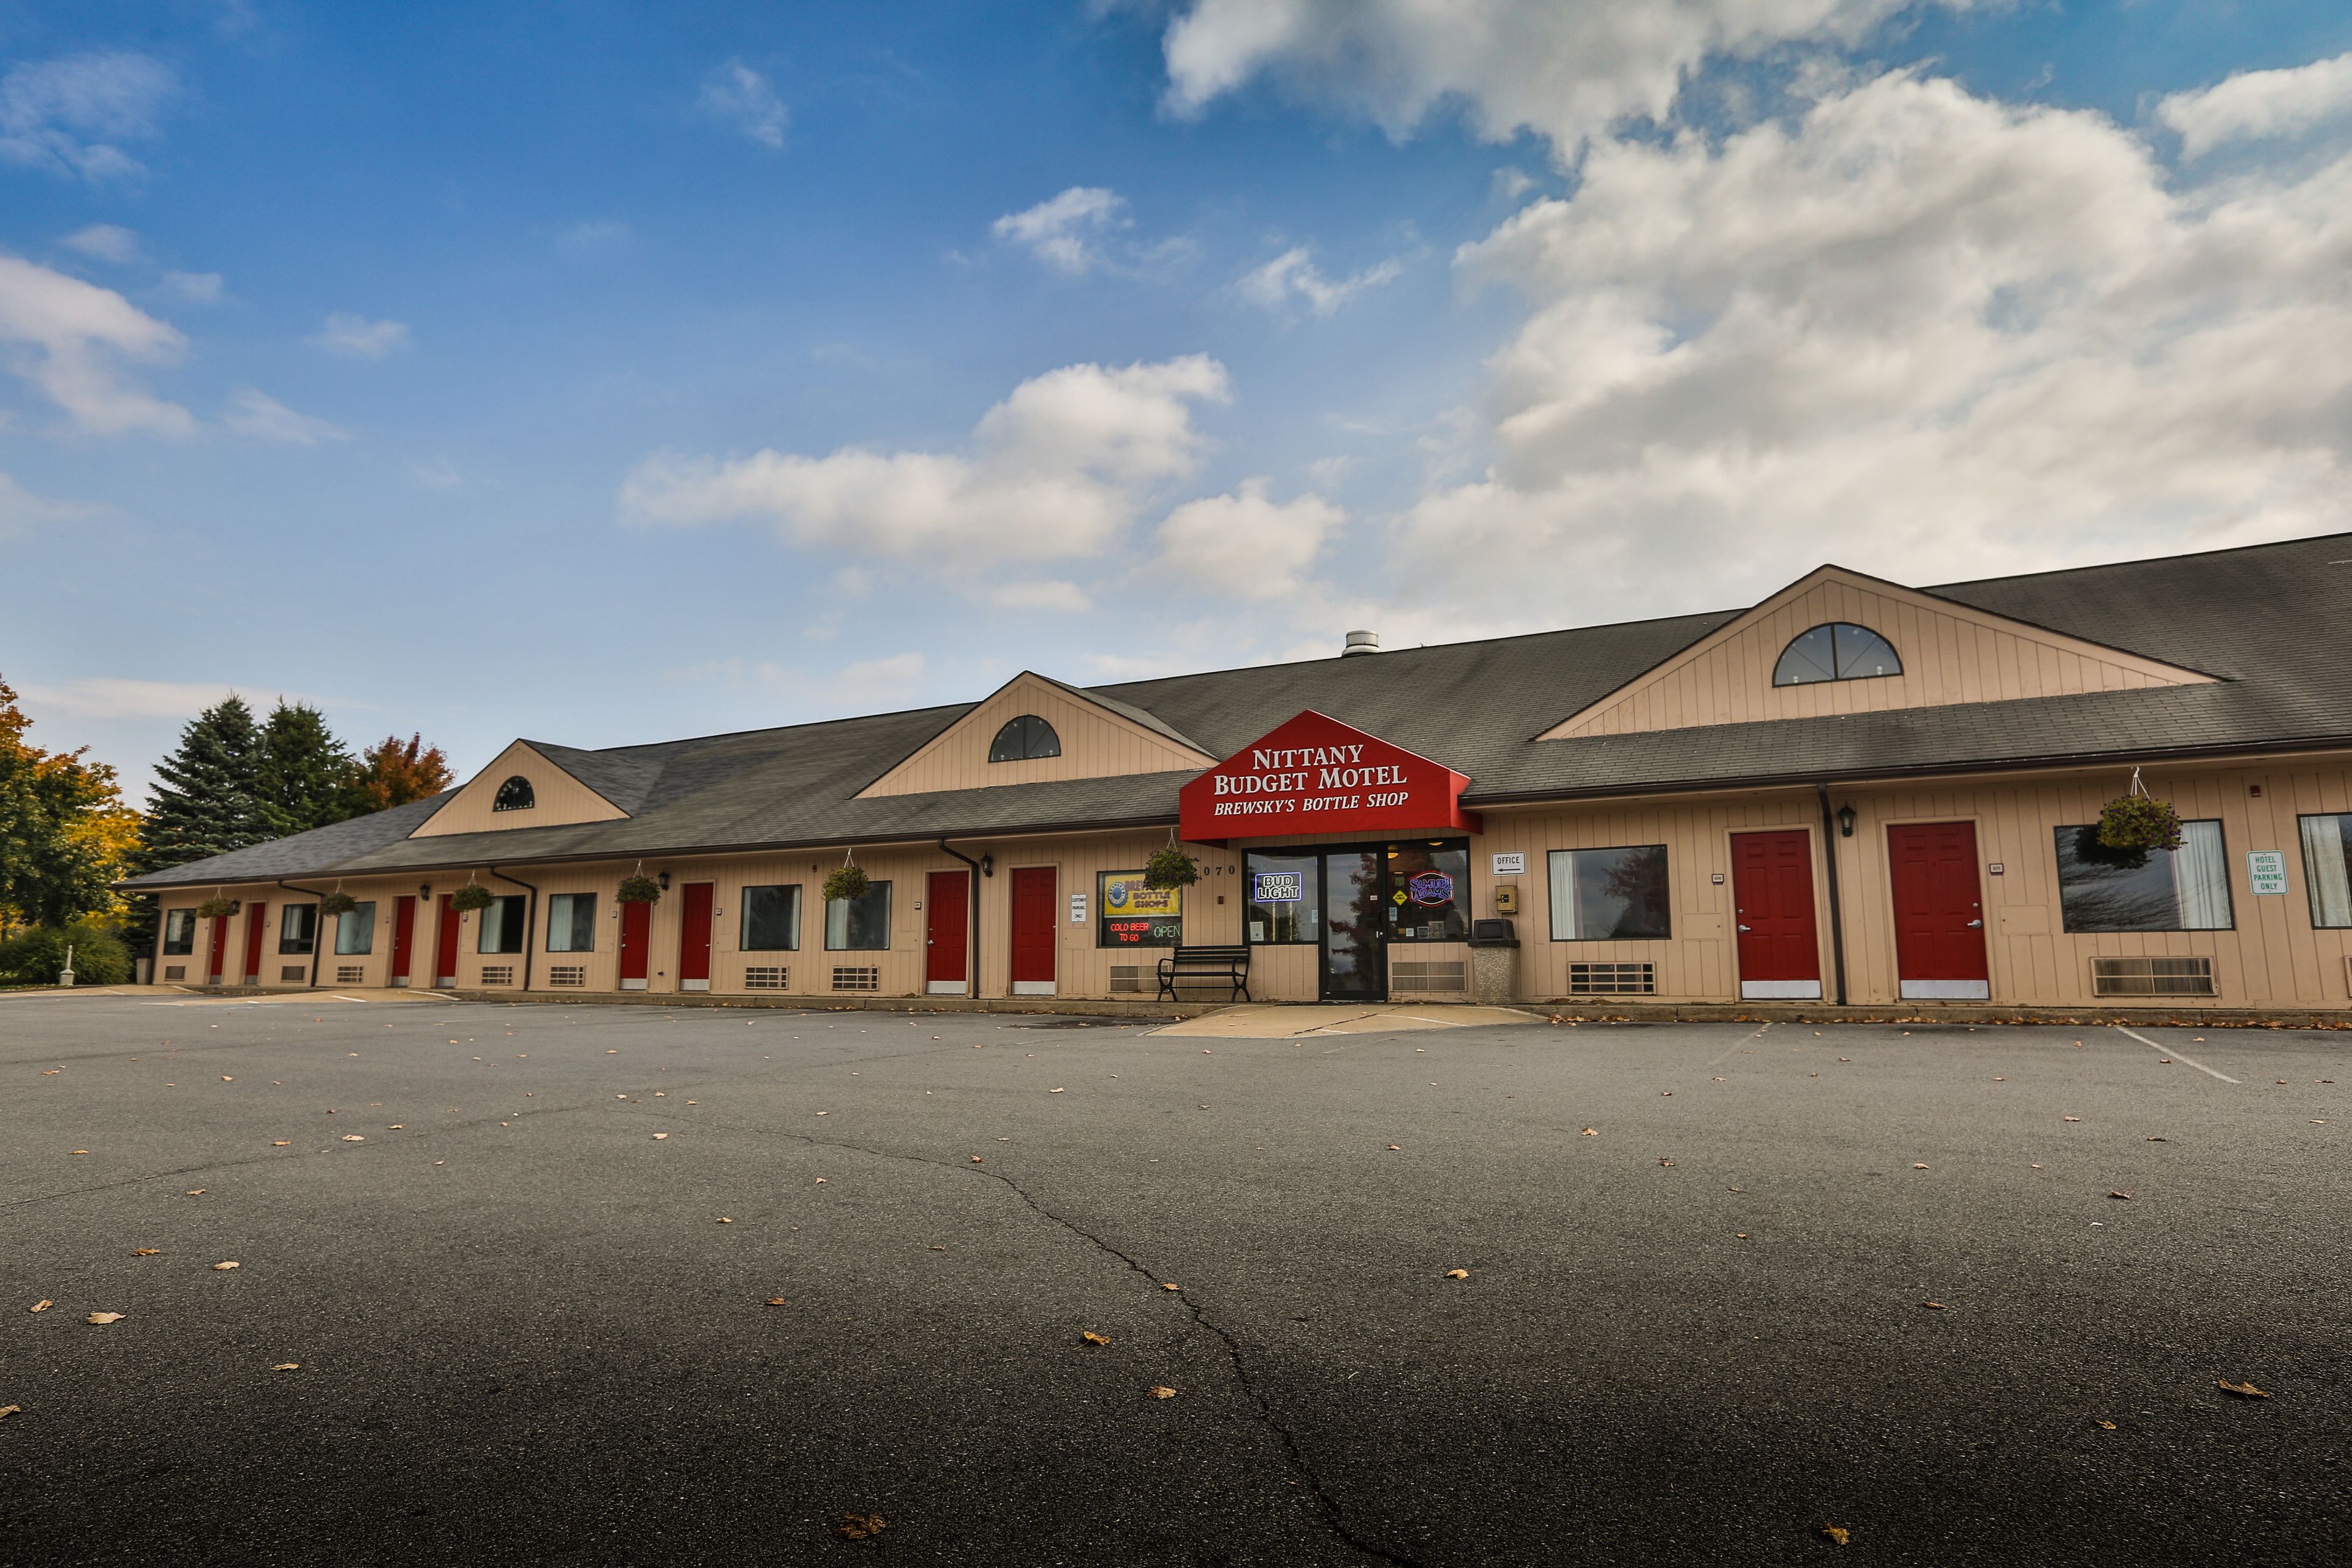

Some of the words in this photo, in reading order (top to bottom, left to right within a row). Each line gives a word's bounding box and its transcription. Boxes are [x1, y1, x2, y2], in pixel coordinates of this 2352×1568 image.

[1253, 744, 1363, 770] NITTANY
[1214, 772, 1308, 796] BUDGET
[1317, 765, 1408, 789] MOTEL
[1214, 799, 1295, 816] BREWSKY'S
[1302, 795, 1360, 812] BOTTLE
[1366, 792, 1409, 807] SHOP
[1263, 875, 1294, 888] BUD
[1410, 877, 1453, 891] SAMUEL
[1133, 891, 1170, 900] BOTTLE
[1257, 886, 1299, 899] LIGHT
[1414, 888, 1450, 902] ADAMS
[1130, 922, 1149, 931] BEER
[1154, 925, 1180, 938] OPEN
[1119, 933, 1128, 941] TO
